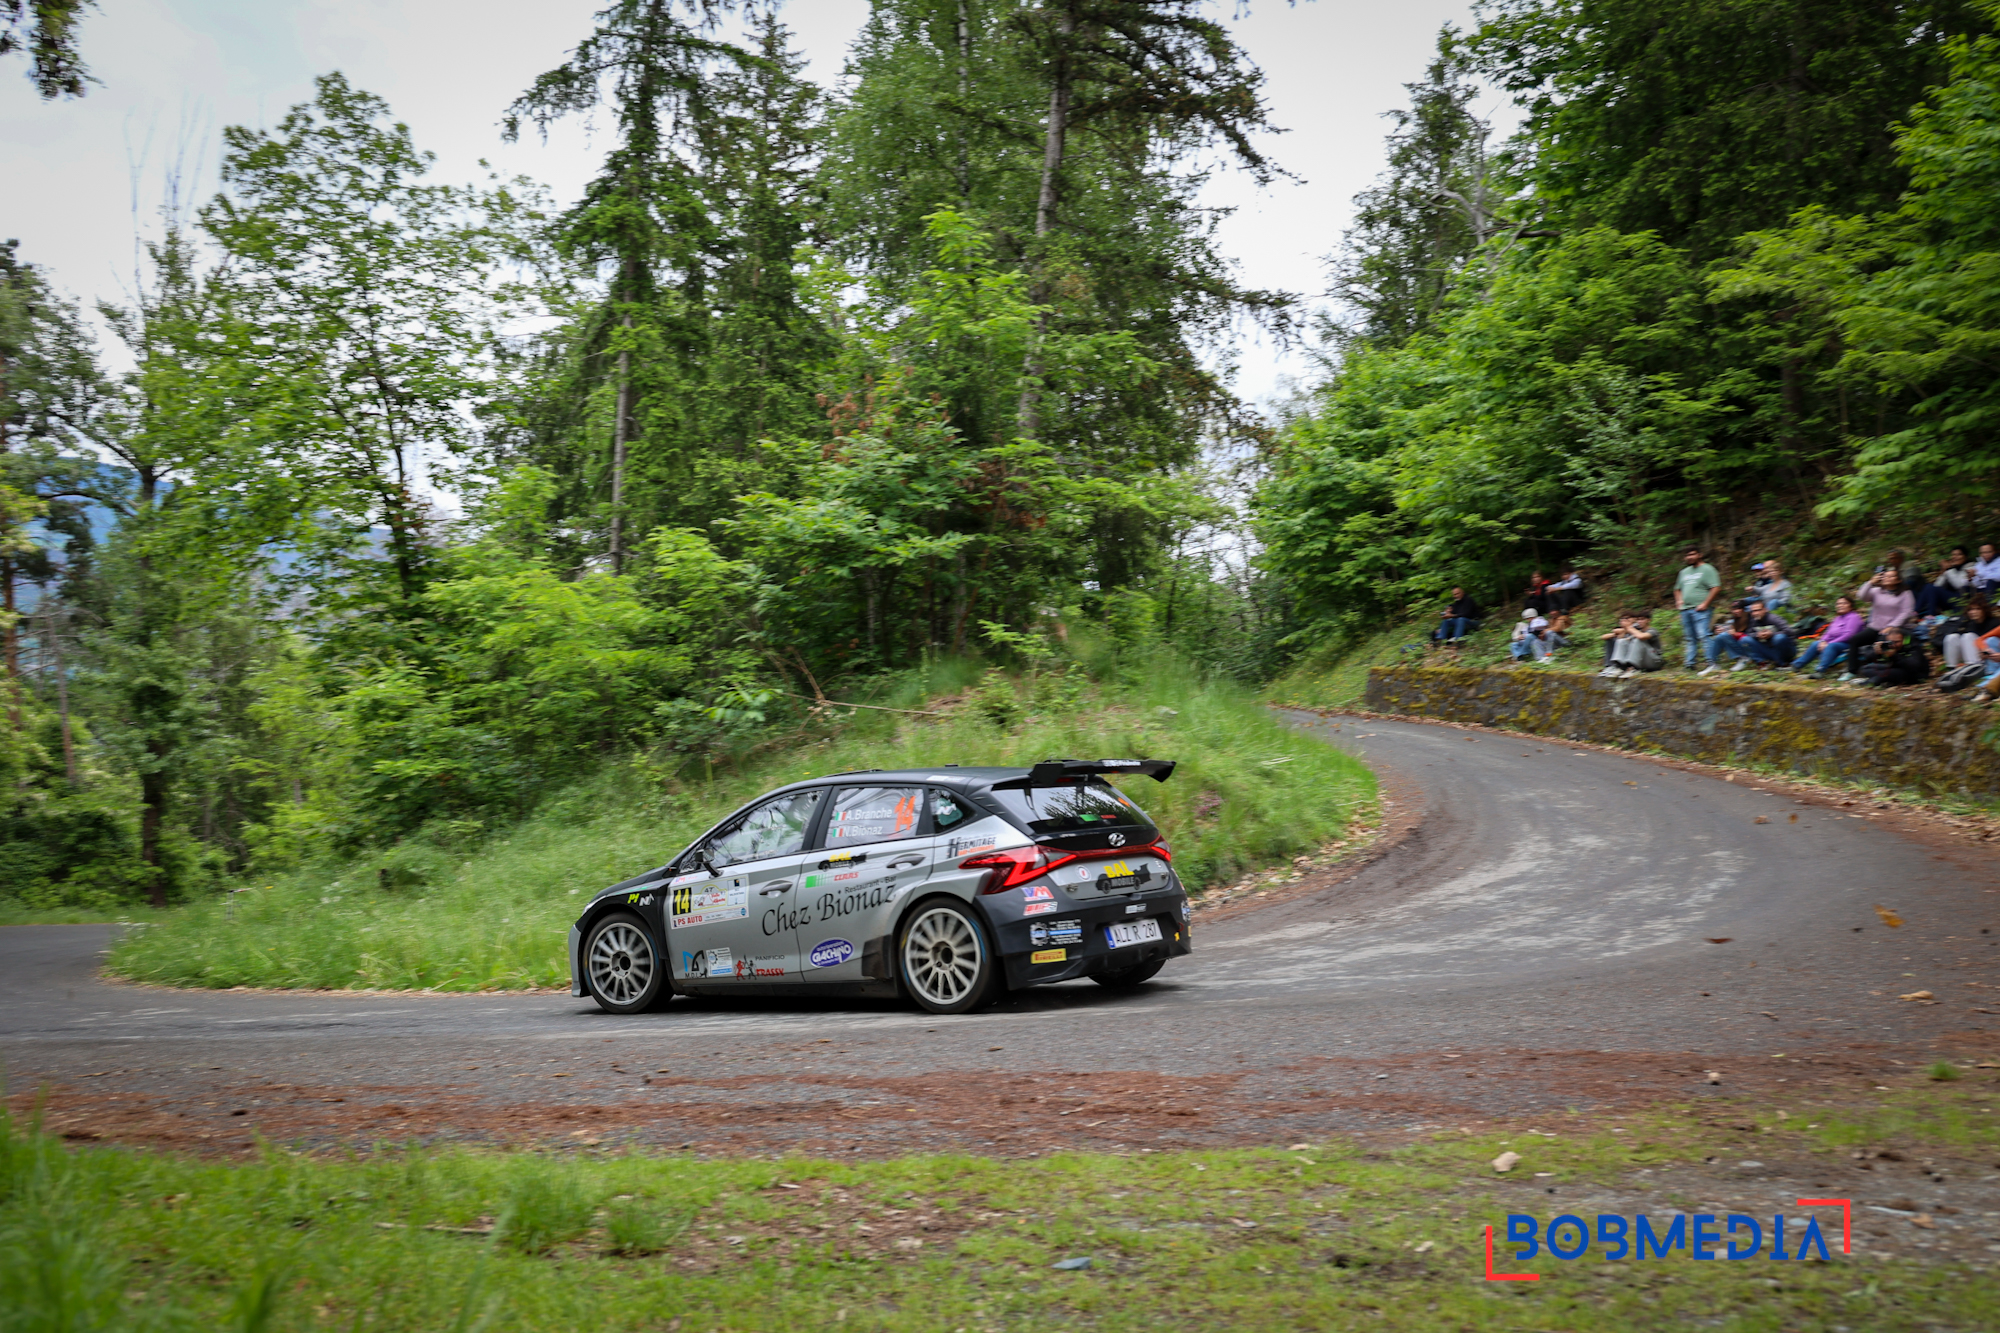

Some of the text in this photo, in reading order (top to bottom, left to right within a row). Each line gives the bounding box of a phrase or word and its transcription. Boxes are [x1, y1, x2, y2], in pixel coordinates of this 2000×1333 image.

[845, 808, 893, 821] A.Branche
[894, 795, 916, 832] 14
[842, 825, 883, 838] N.Bionaz
[1103, 861, 1135, 878] BAL
[844, 880, 879, 894] Restaurant
[885, 876, 896, 884] Bar
[674, 888, 690, 914] 14
[762, 884, 896, 936] Chez Bionaz
[687, 916, 703, 924] AUTO
[1113, 922, 1157, 944] ALZ R 287
